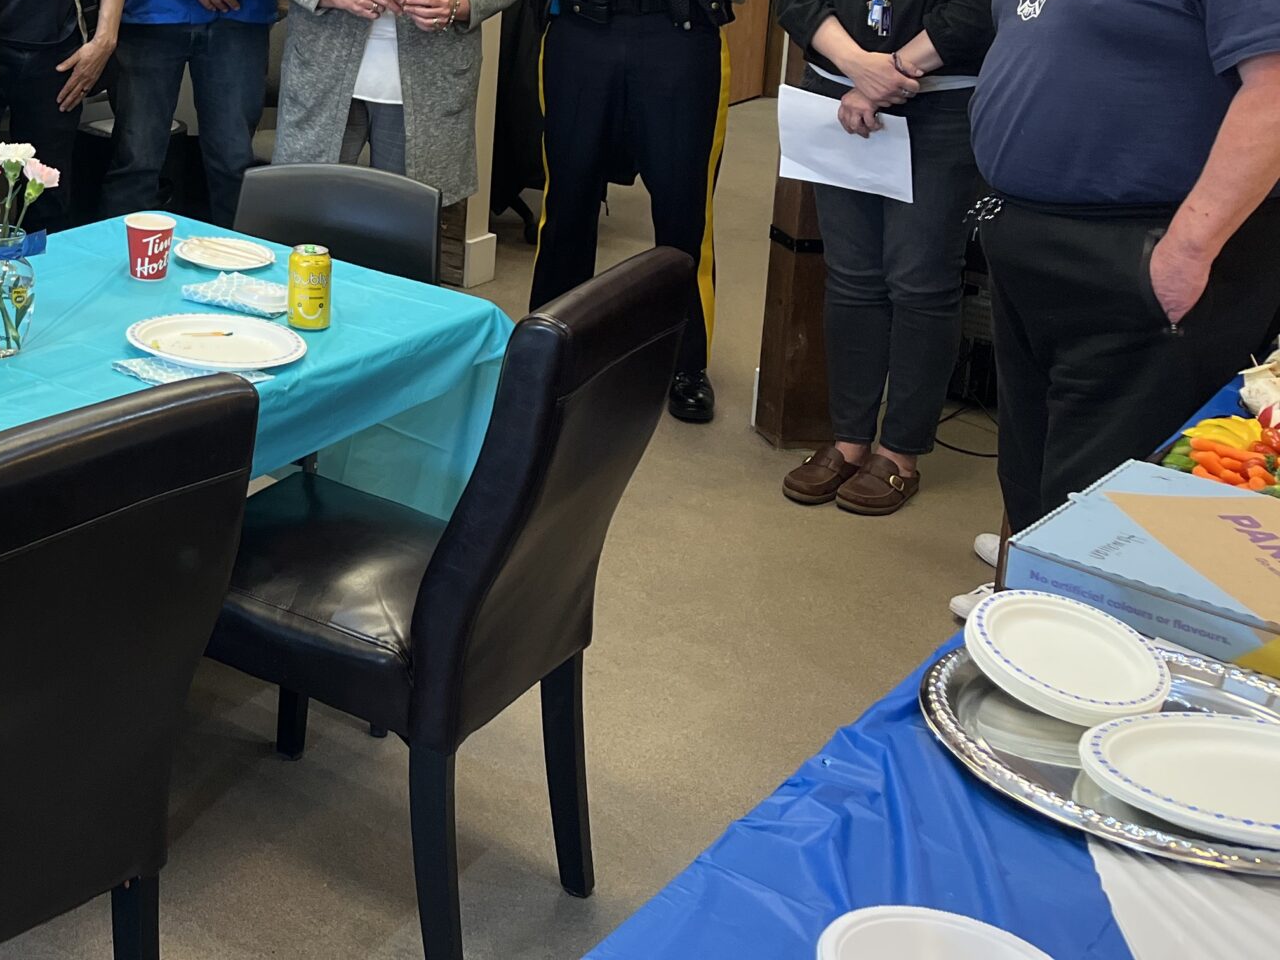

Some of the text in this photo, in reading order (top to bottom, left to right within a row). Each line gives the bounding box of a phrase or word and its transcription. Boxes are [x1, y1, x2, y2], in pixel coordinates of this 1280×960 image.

[1029, 569, 1048, 584] No
[1051, 580, 1104, 603] artificial
[1107, 598, 1153, 620] colours
[1156, 615, 1170, 625] or
